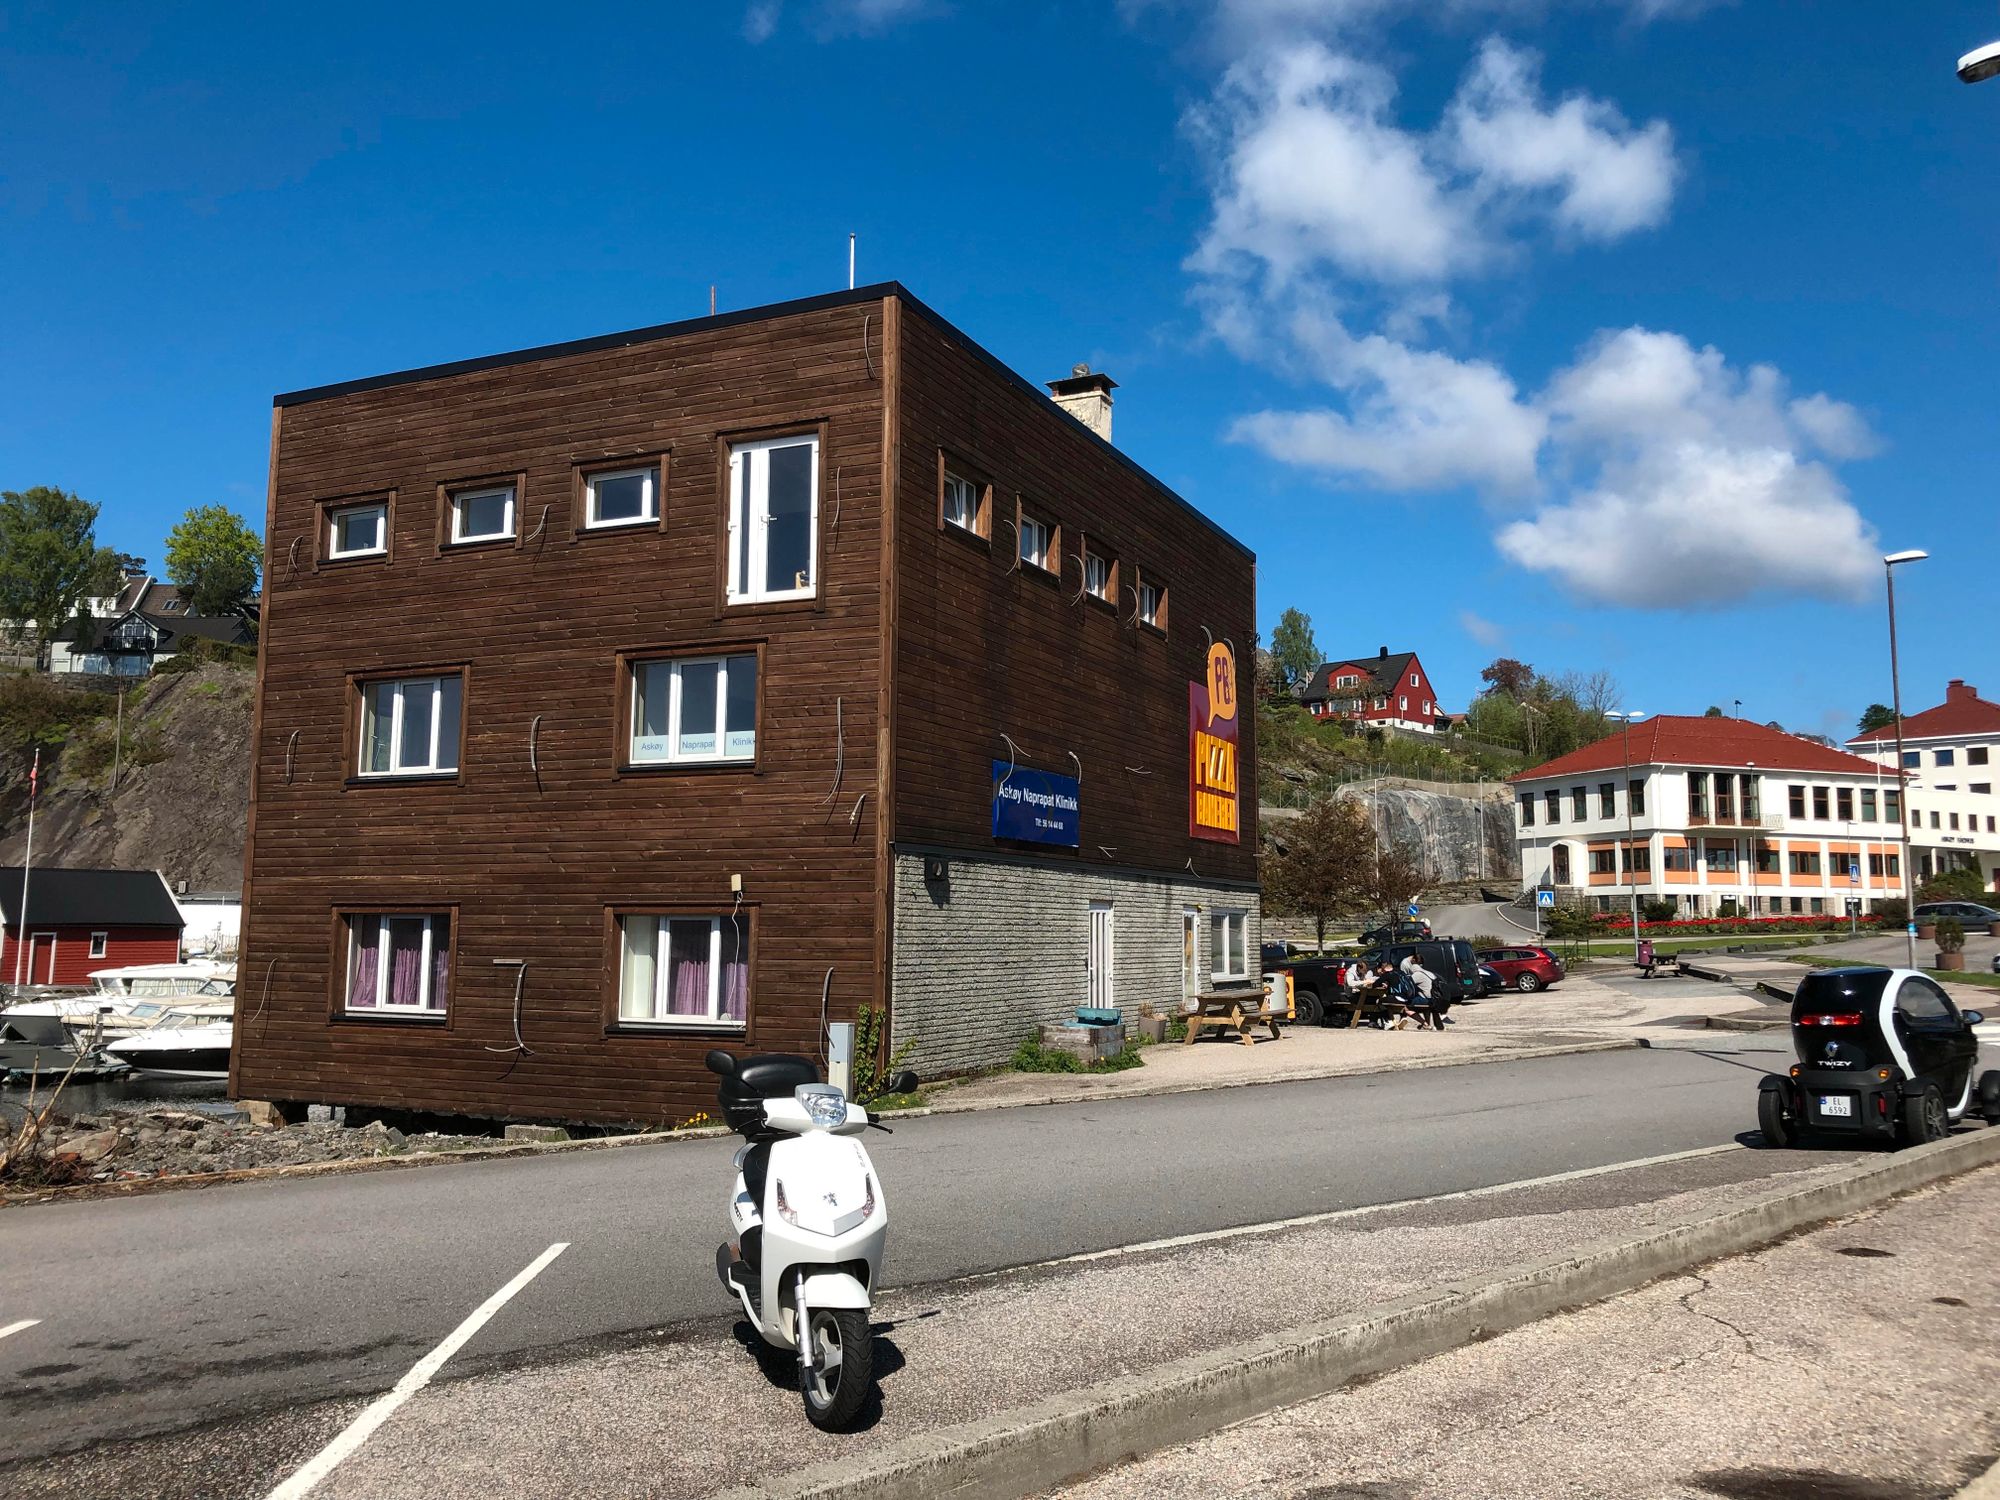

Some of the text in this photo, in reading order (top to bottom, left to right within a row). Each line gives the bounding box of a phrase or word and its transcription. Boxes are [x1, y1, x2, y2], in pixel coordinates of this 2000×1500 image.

[1214, 656, 1231, 705] PB
[641, 741, 664, 752] Askøy
[1196, 730, 1236, 794] PIZZA
[999, 785, 1078, 811] Askøy Naprapat Klinikk
[1828, 1106, 1847, 1114] 6592
[1833, 1097, 1841, 1105] EL
